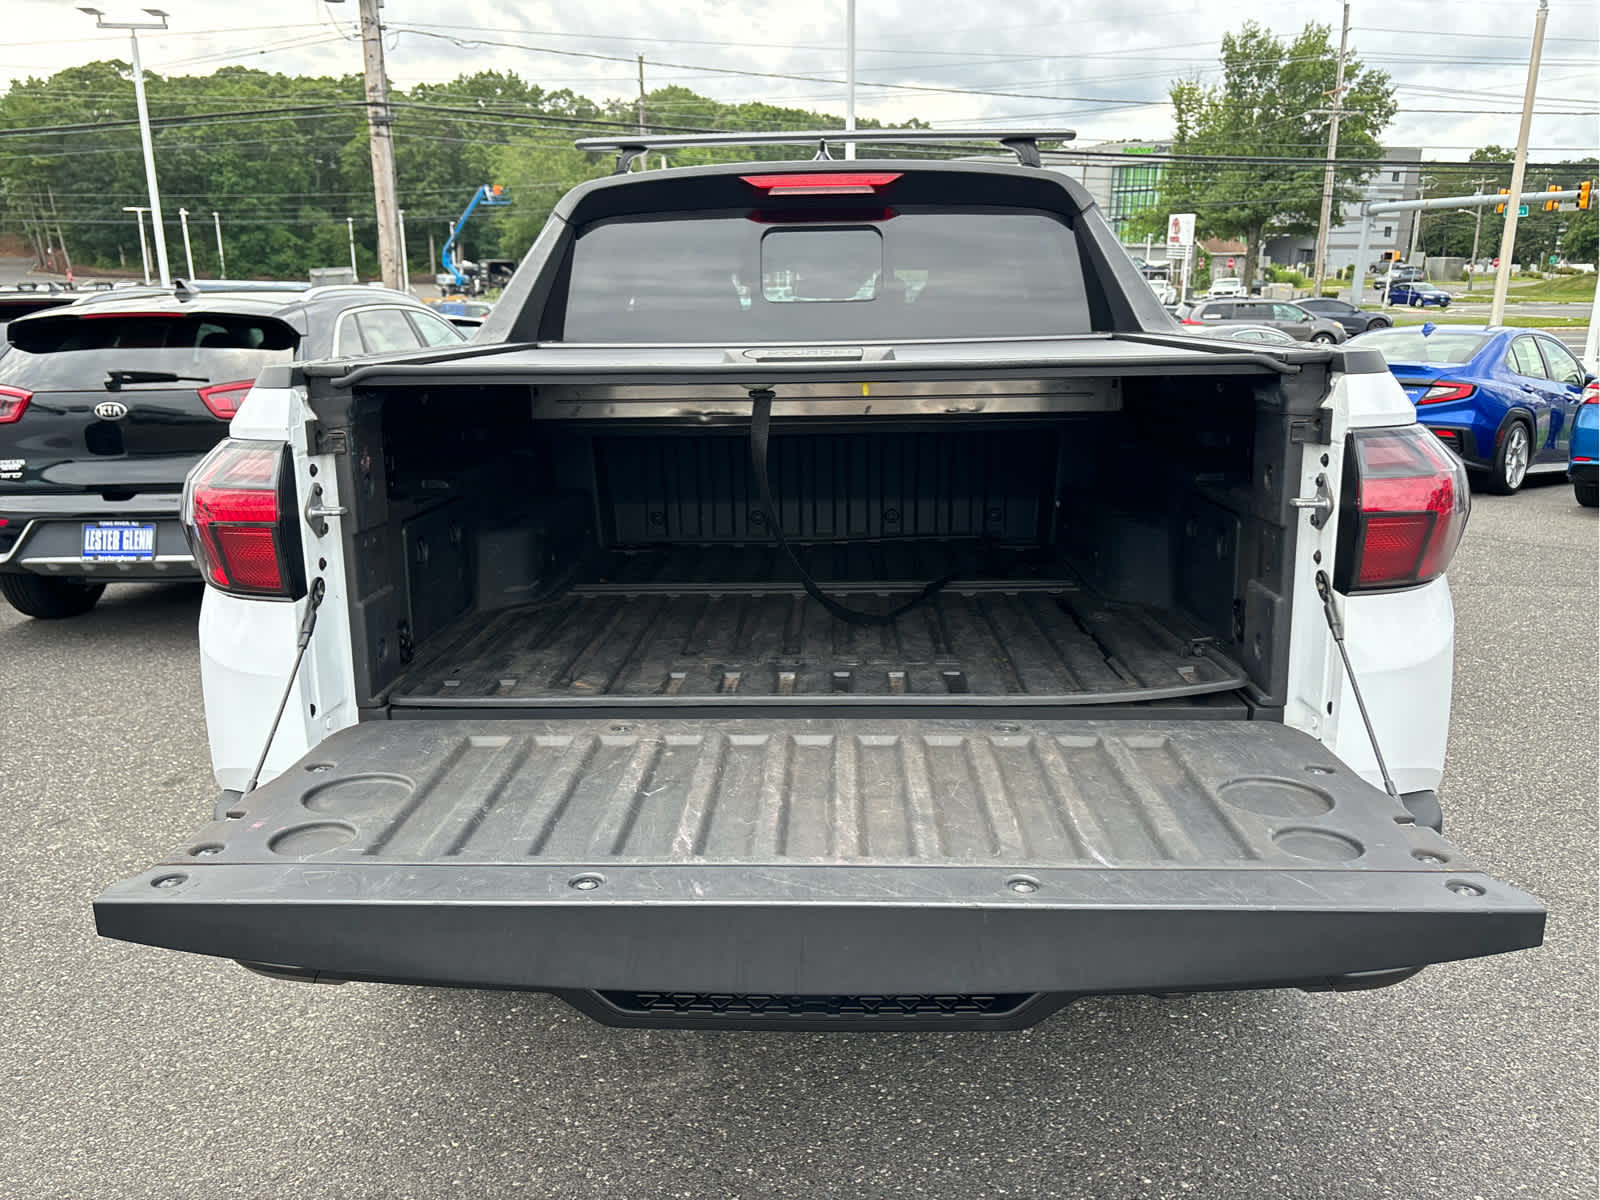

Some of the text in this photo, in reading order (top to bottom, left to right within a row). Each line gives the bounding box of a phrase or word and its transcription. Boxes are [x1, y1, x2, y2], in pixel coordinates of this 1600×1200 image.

[99, 404, 122, 417] KIA
[85, 529, 153, 550] LESTER GLENN
